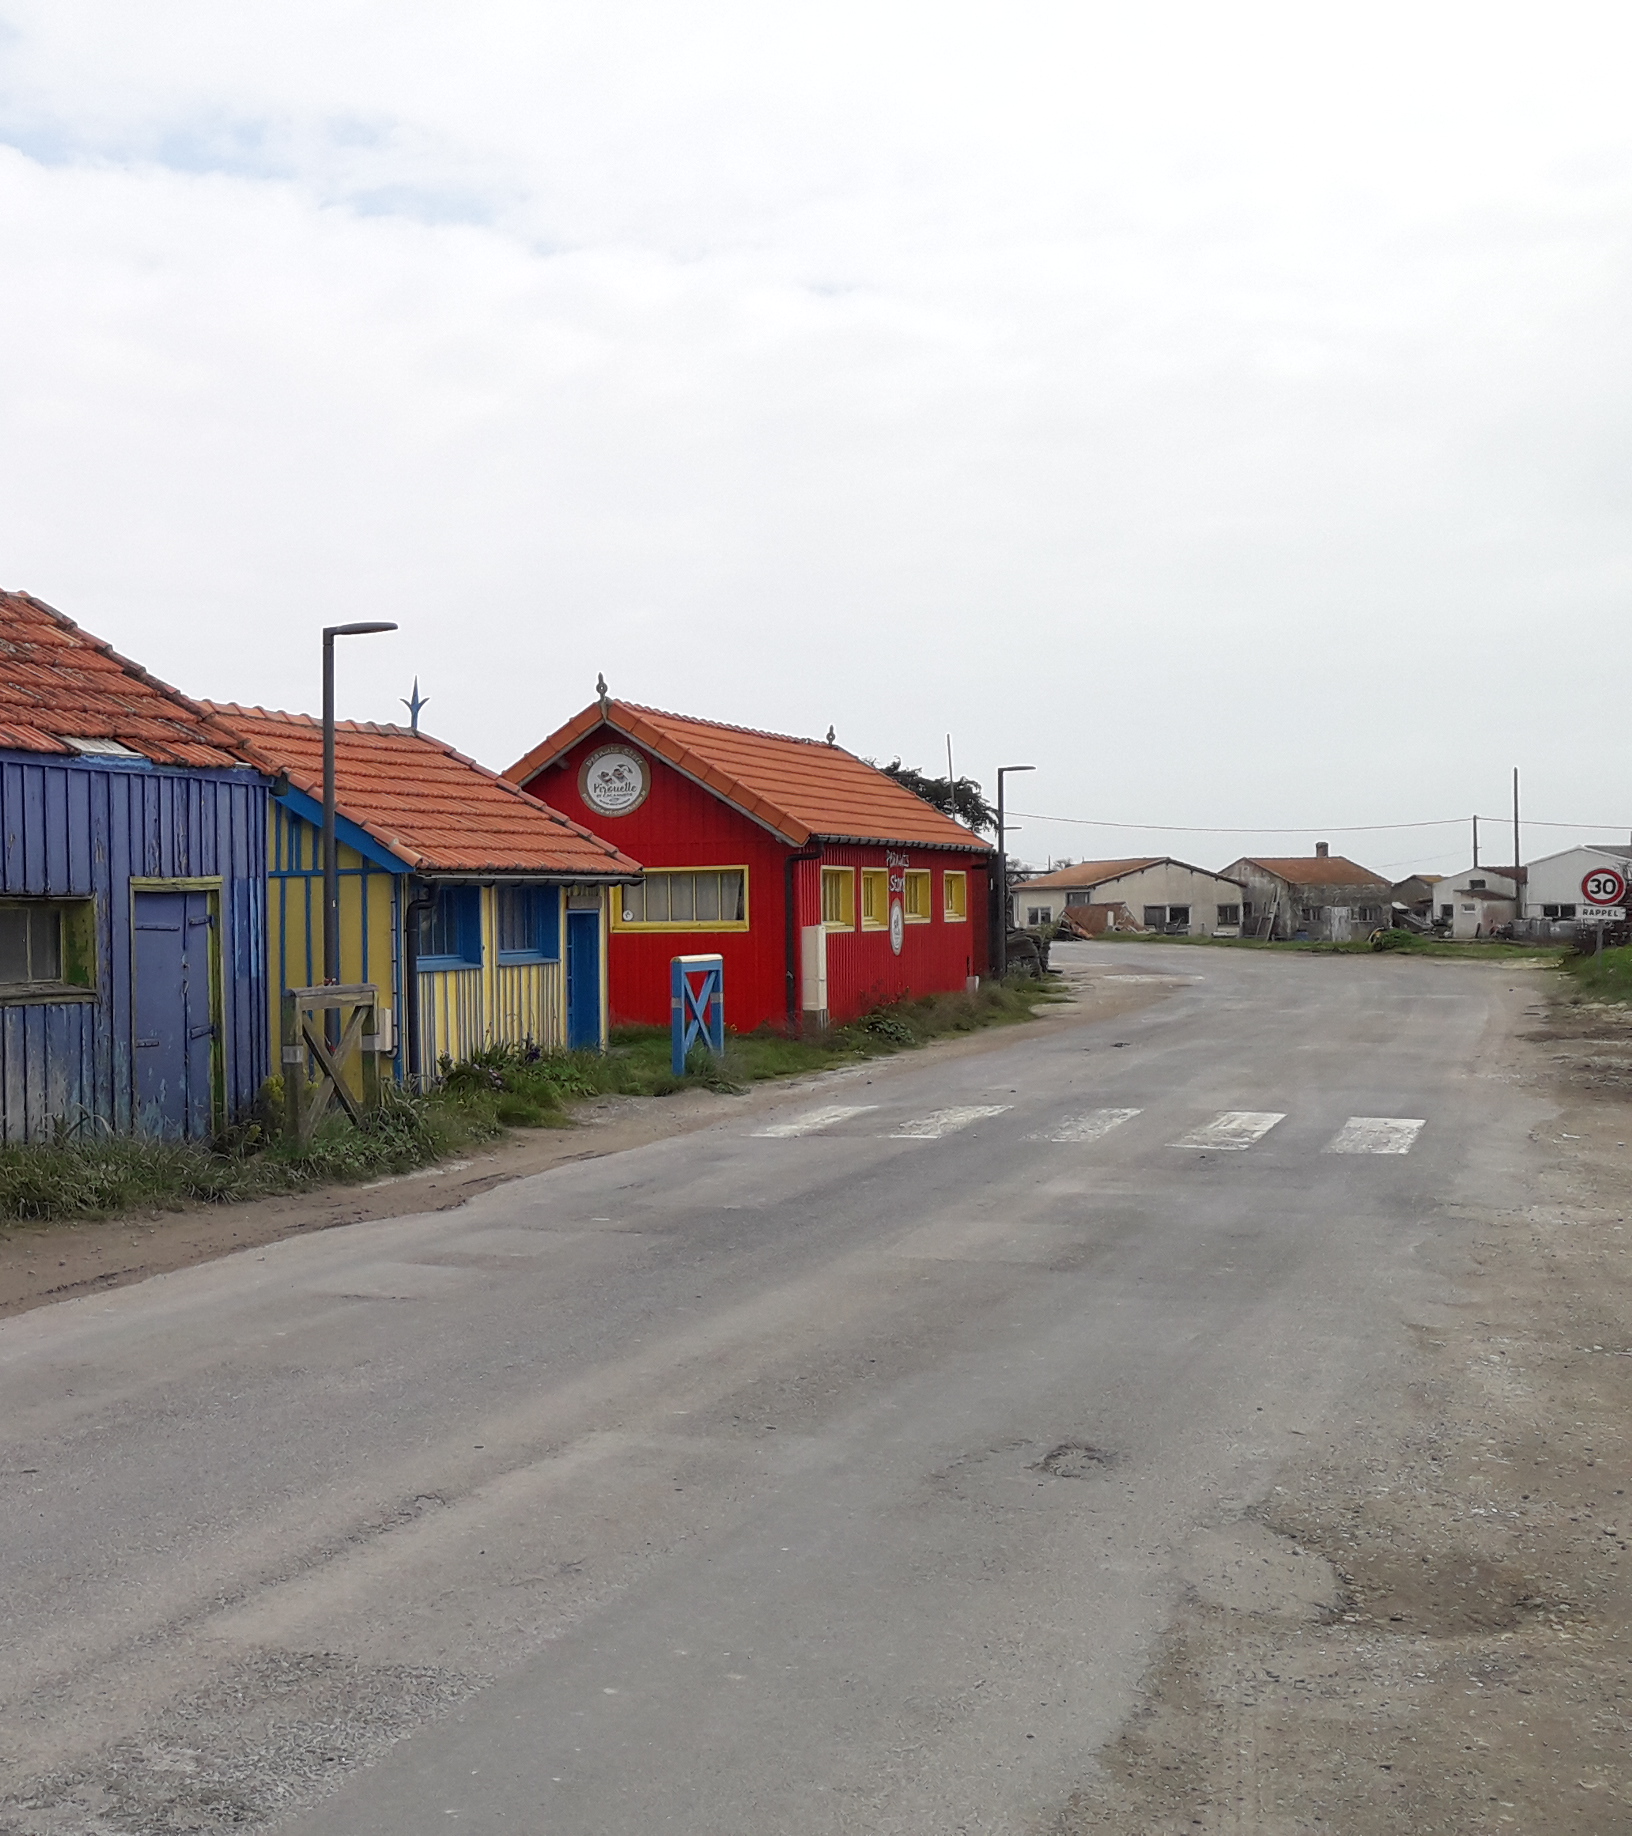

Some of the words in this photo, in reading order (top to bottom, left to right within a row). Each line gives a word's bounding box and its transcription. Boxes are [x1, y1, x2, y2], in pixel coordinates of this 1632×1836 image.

[593, 781, 637, 796] Pirouette
[1589, 878, 1617, 895] 30
[1582, 908, 1619, 917] RAPPEL
